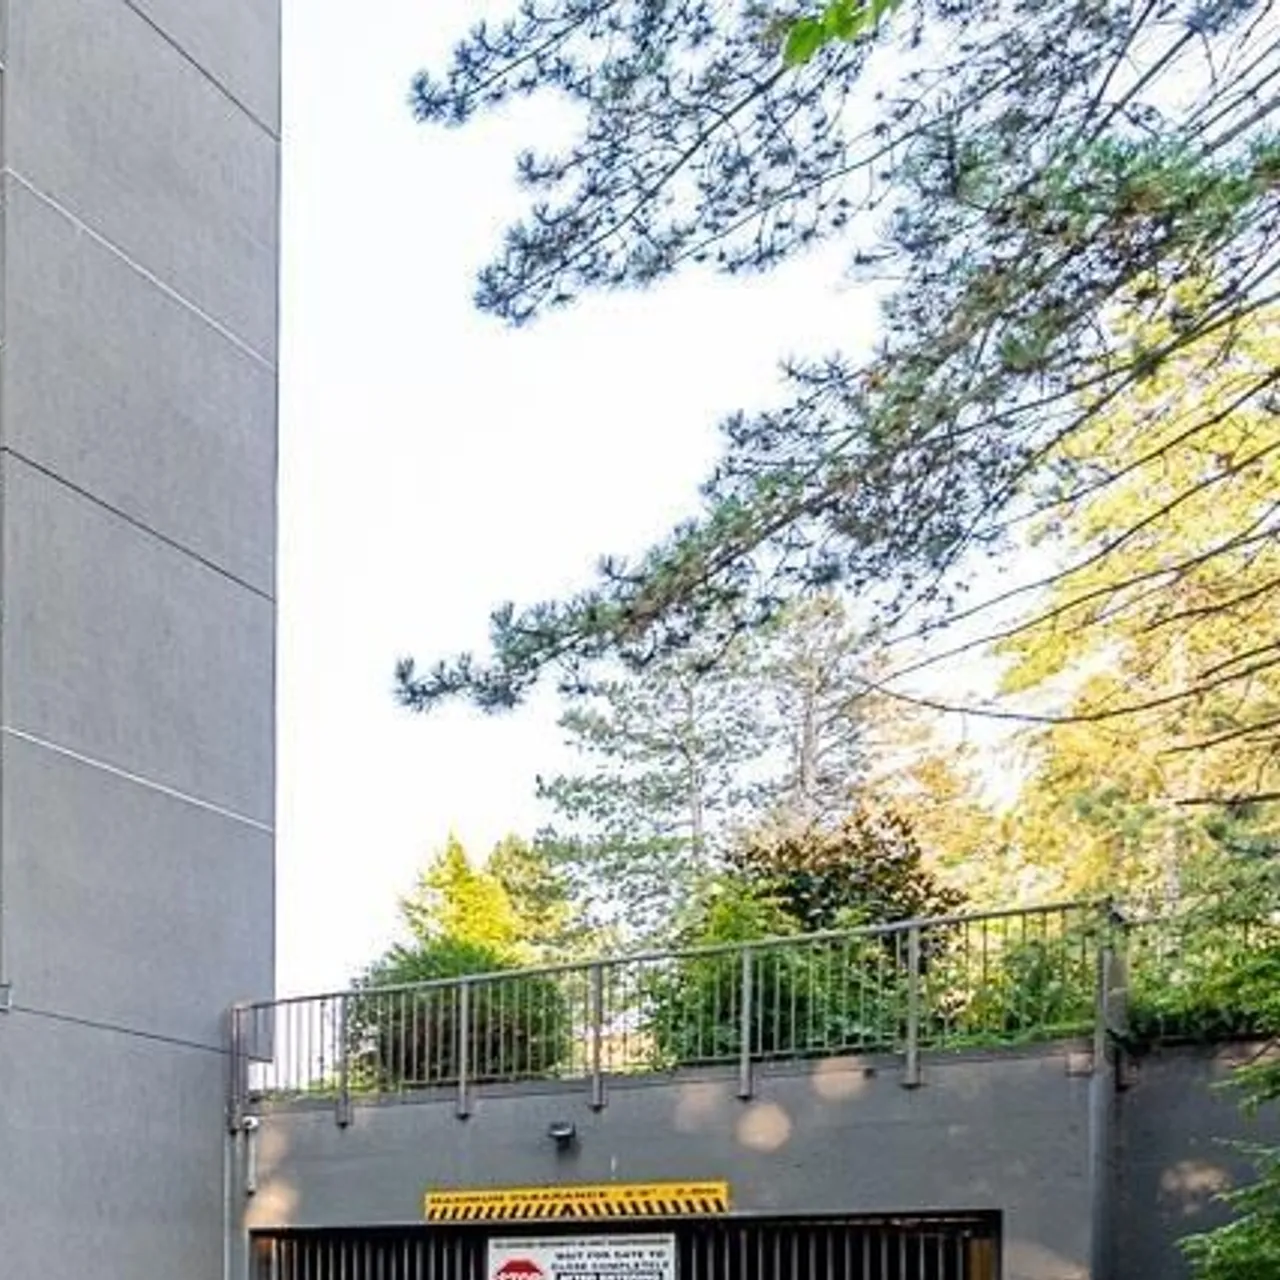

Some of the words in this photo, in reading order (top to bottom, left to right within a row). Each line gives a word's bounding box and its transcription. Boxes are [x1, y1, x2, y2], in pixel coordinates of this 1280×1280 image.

[509, 1188, 608, 1201] CLEARANCE
[587, 1251, 610, 1259] FOR
[649, 1250, 665, 1258] TO
